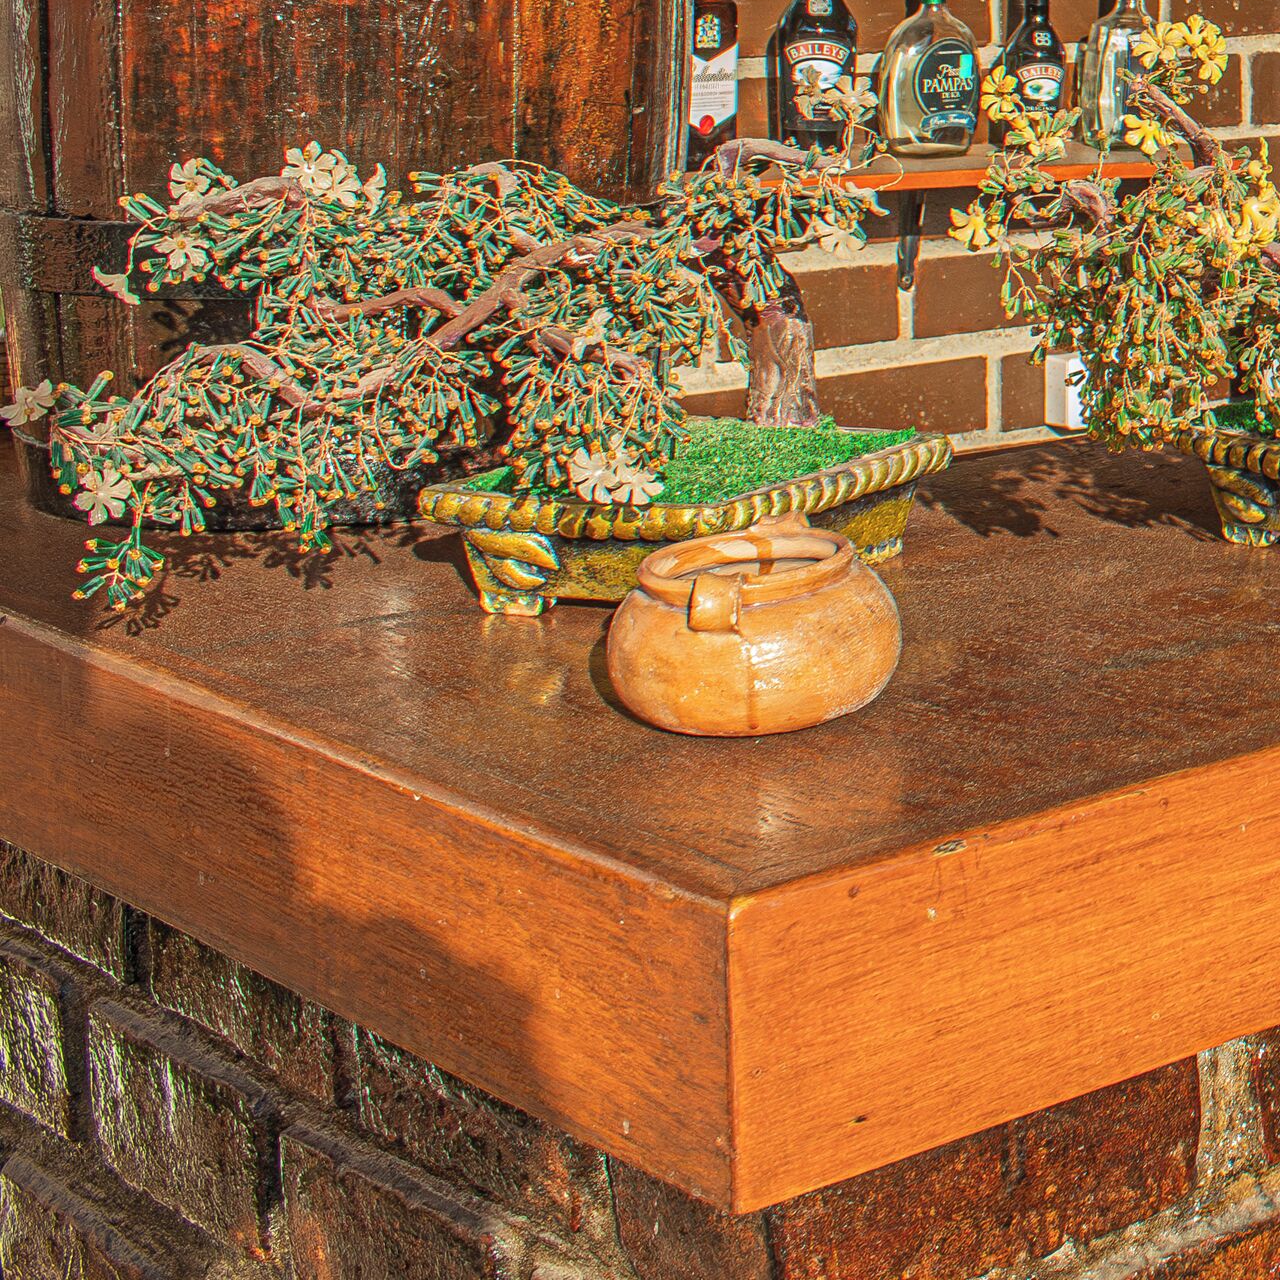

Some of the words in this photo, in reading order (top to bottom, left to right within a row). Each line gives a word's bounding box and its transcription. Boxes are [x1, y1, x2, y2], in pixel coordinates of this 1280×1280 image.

[789, 44, 847, 62] BAILEYS
[1021, 65, 1063, 79] BAILEYS
[922, 75, 975, 93] PAMPAS
